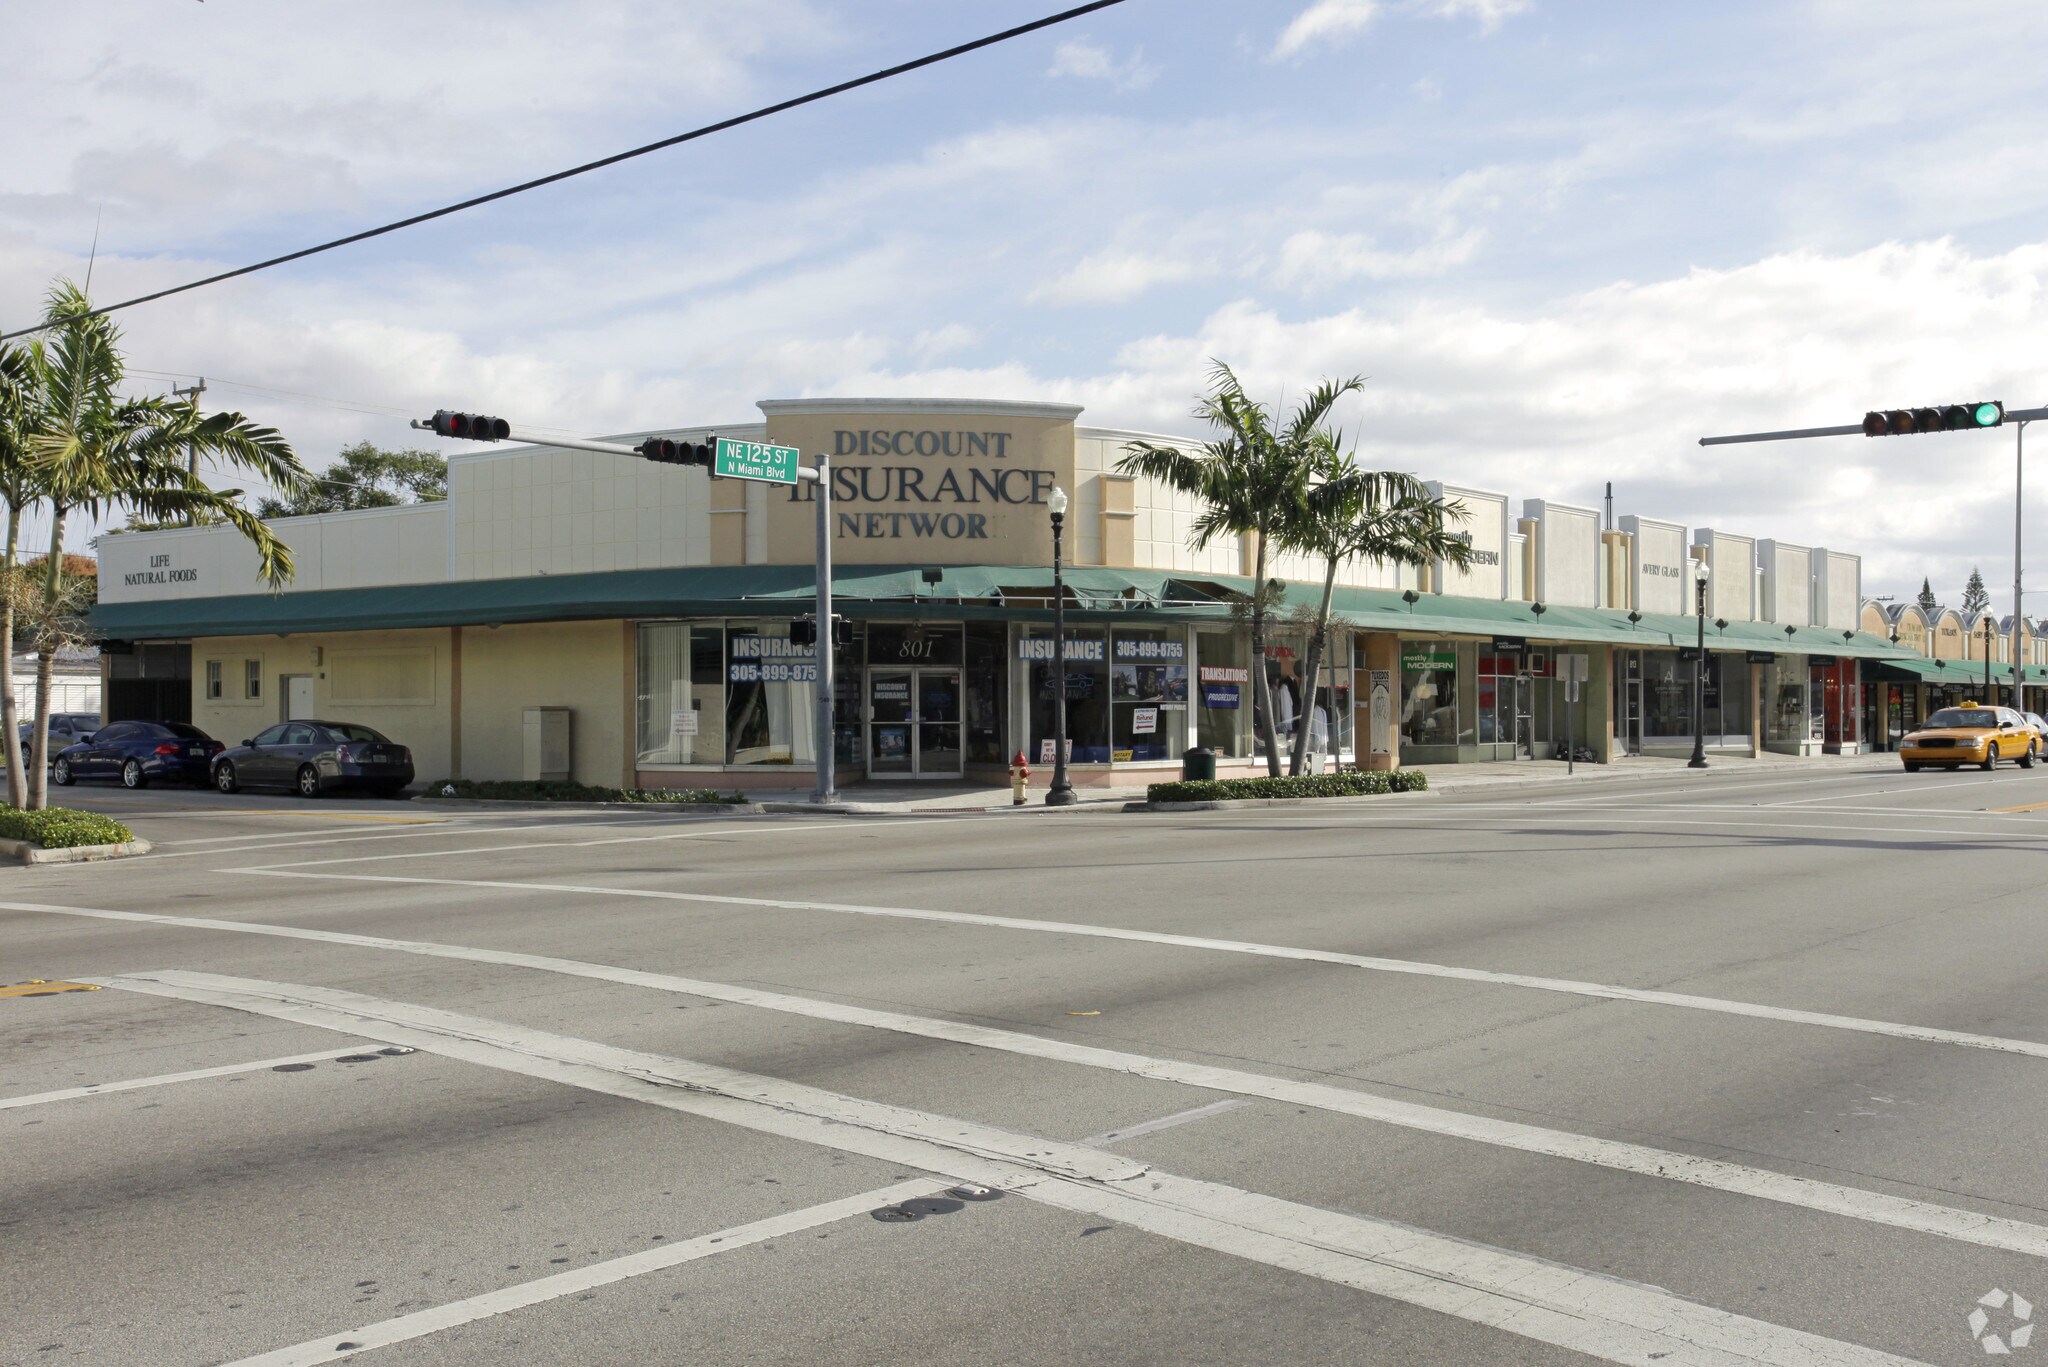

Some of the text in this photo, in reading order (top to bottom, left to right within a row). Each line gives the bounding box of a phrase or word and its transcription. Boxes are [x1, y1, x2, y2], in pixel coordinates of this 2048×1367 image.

[833, 430, 1012, 458] DISCOUNT
[726, 443, 789, 464] NE 125 ST
[728, 461, 785, 479] N Miami Blvd
[837, 512, 989, 539] NETWOR
[150, 554, 170, 568] LIFE
[124, 569, 197, 586] NATURAL FOODS
[1642, 563, 1679, 578] AVERY GLASS
[733, 638, 817, 657] INSURANC
[899, 640, 933, 658] 801
[1019, 639, 1103, 660] INSUANCE
[1117, 641, 1183, 658] 305-899-8755
[1403, 654, 1427, 663] mostly
[731, 664, 817, 681] 305-899-875
[1200, 667, 1248, 682] TRANSLATIONS
[876, 683, 907, 691] DISCOUNT
[1039, 689, 1092, 699] INSANCE
[1207, 693, 1239, 702] PROGRESSIVE
[1042, 753, 1069, 763] CLOD
